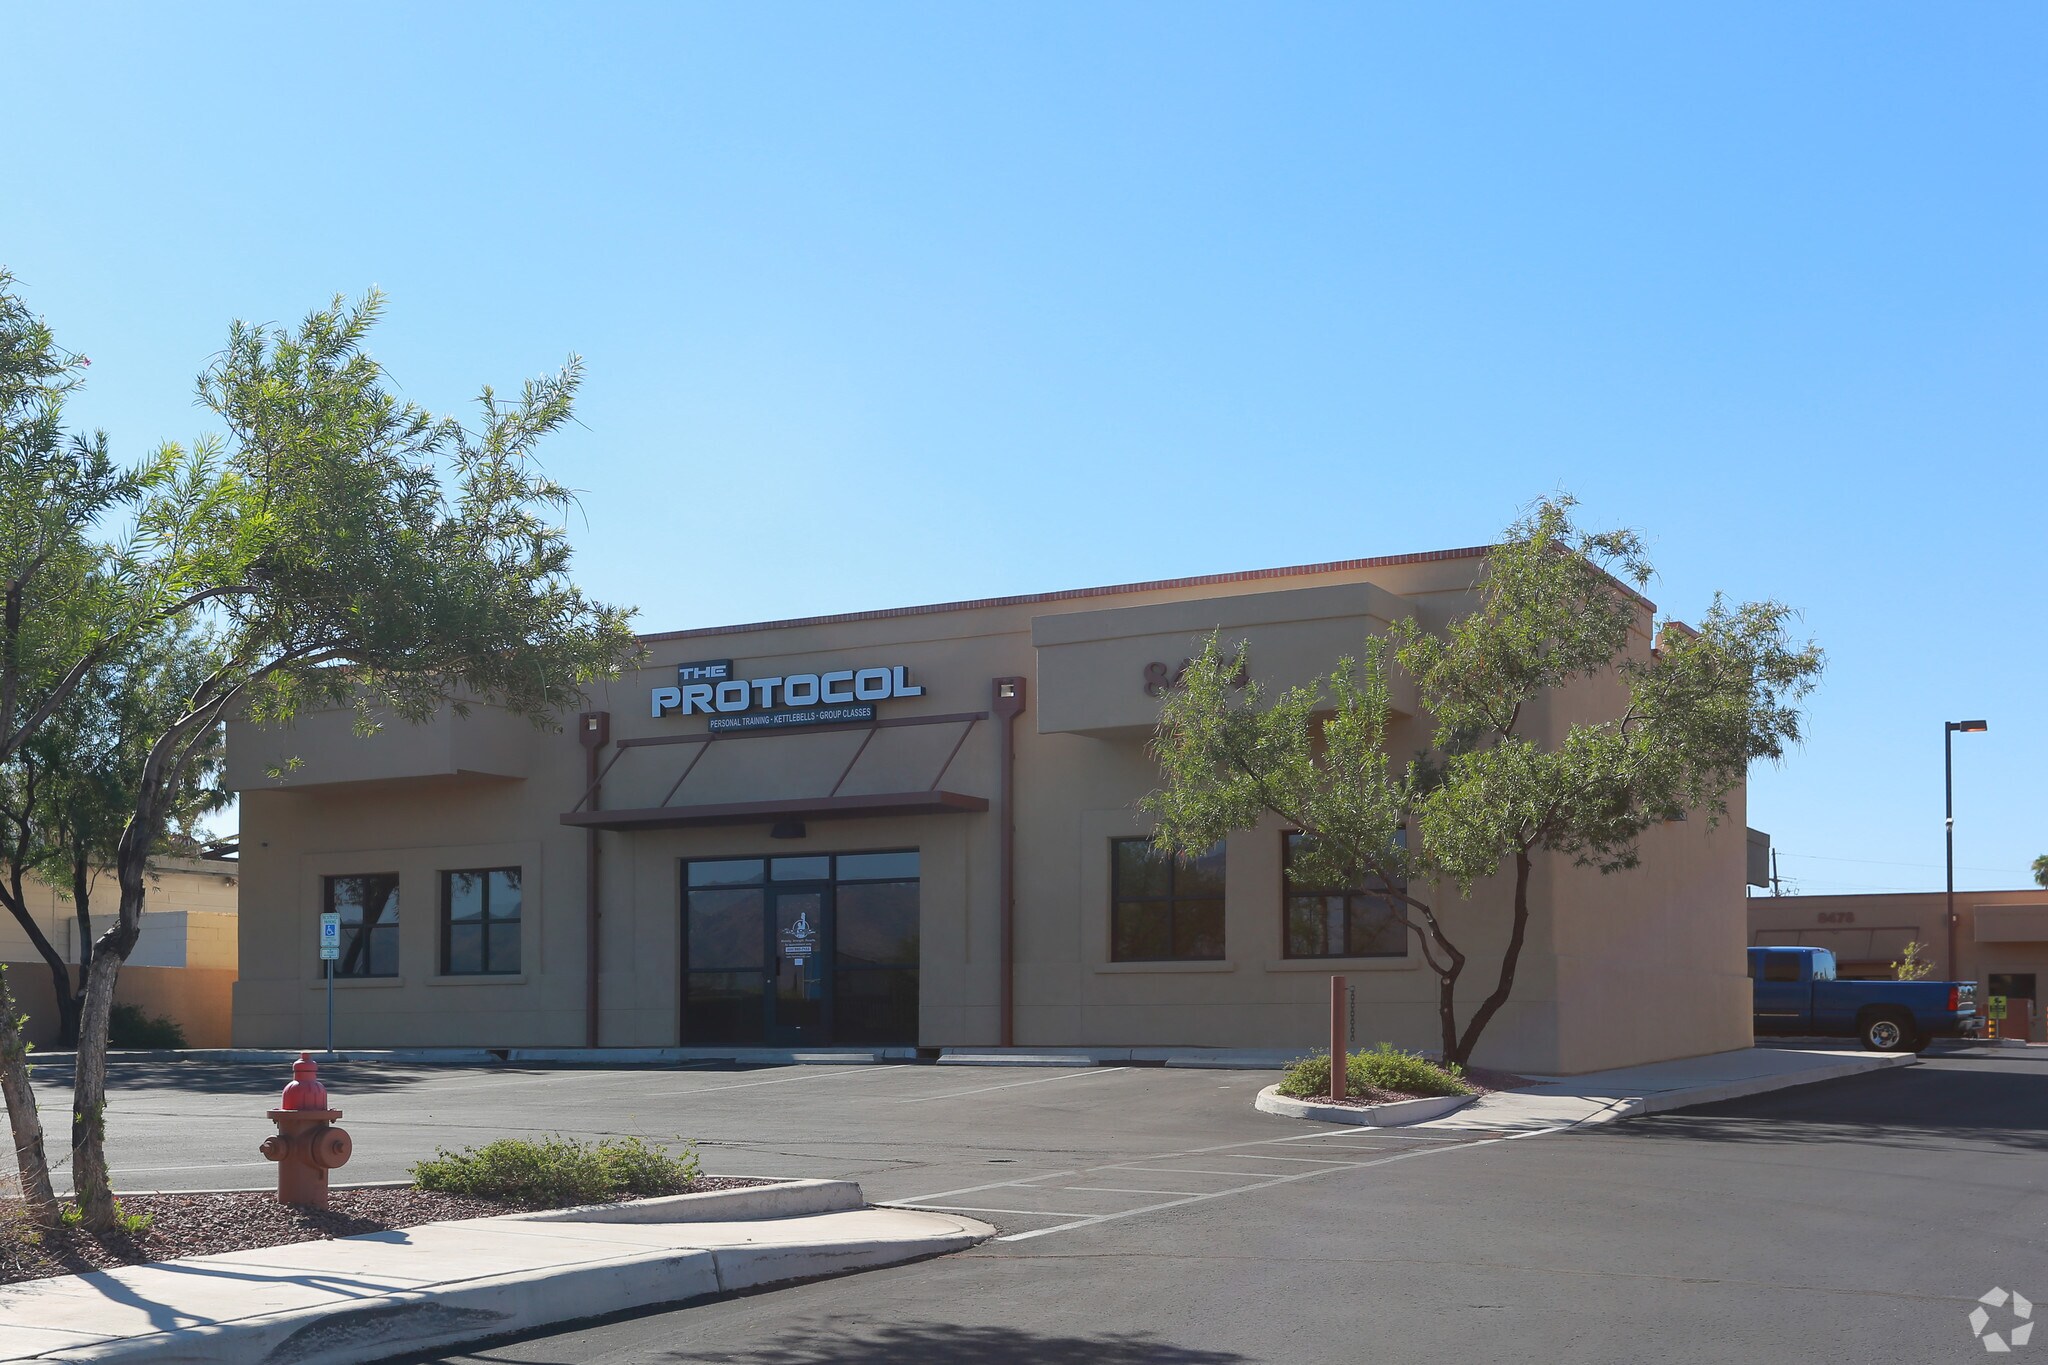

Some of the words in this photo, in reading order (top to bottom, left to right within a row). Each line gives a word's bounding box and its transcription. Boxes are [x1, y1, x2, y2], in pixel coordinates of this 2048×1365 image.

[679, 664, 727, 680] THE
[651, 665, 923, 718] PROTOCOL
[710, 718, 741, 728] PERSONAL
[742, 715, 770, 726] TRAINING
[773, 712, 816, 723] KETTLEBELLS
[819, 709, 842, 720] GROUP
[842, 707, 871, 718] CLASSES
